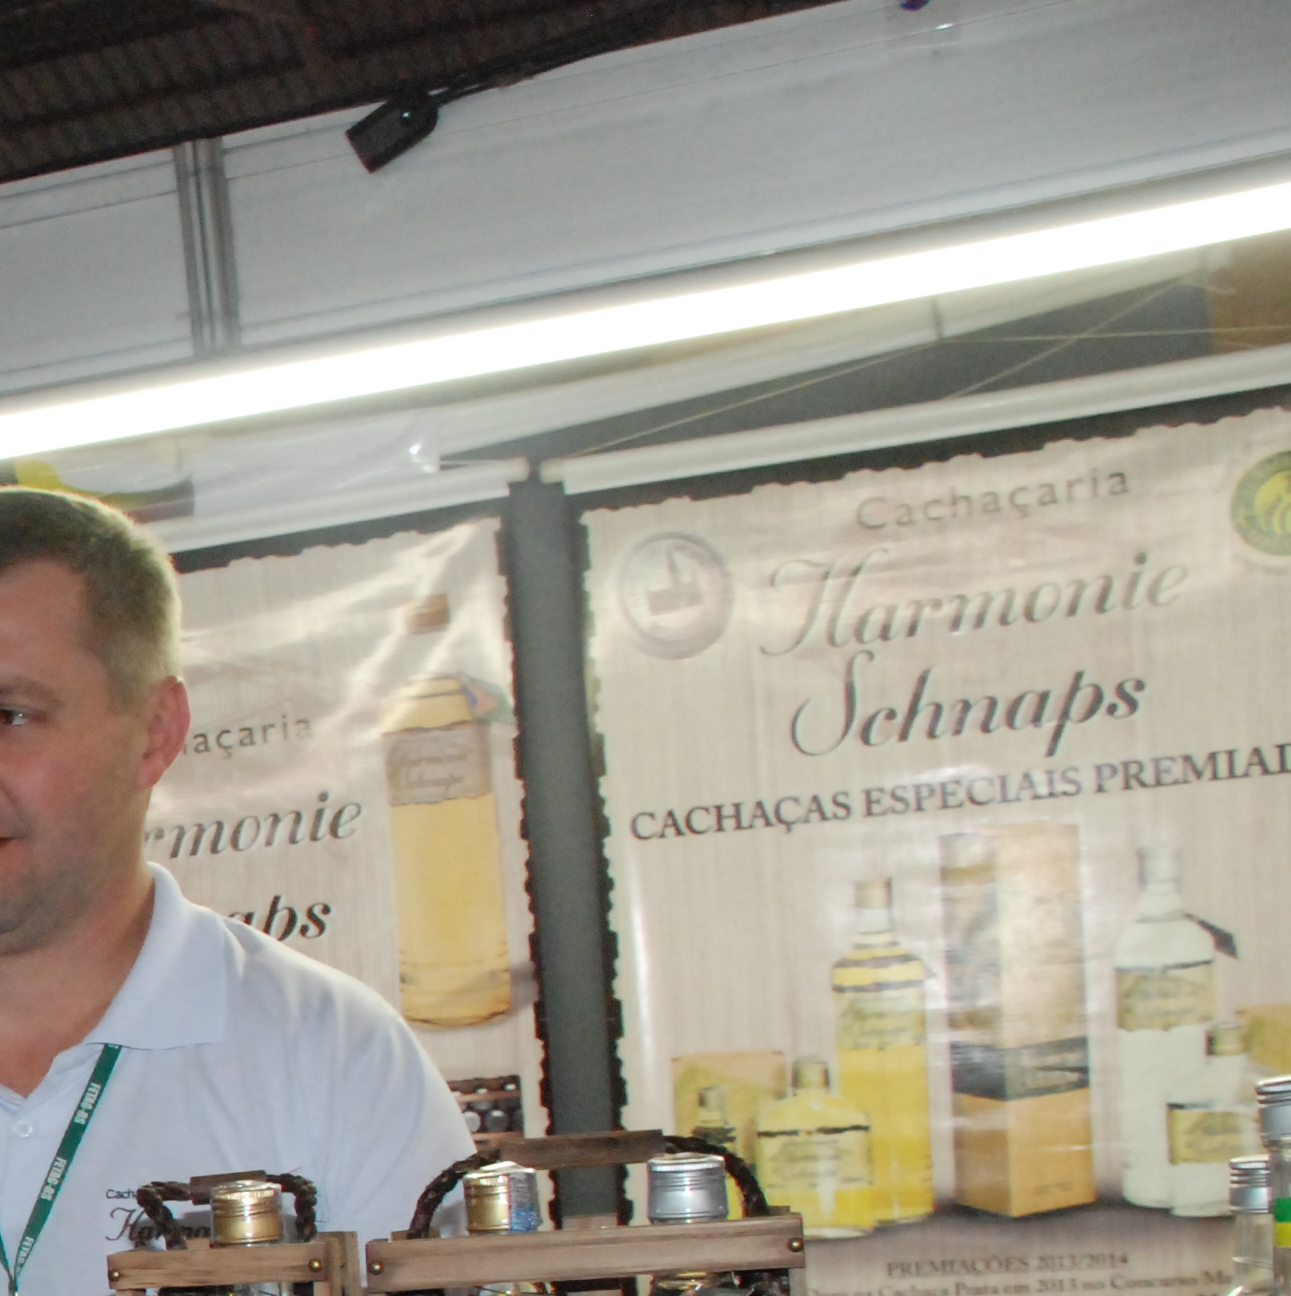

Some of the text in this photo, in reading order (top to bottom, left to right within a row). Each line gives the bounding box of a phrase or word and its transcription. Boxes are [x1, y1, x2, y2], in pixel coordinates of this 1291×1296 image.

[855, 467, 1130, 531] Cachaçaria
[760, 549, 1189, 658] Harmonie
[182, 714, 315, 759] açaria
[790, 648, 1146, 758] Schnaps
[629, 788, 852, 841] CACHAÇAS
[862, 766, 1082, 818] ESPECIAIS
